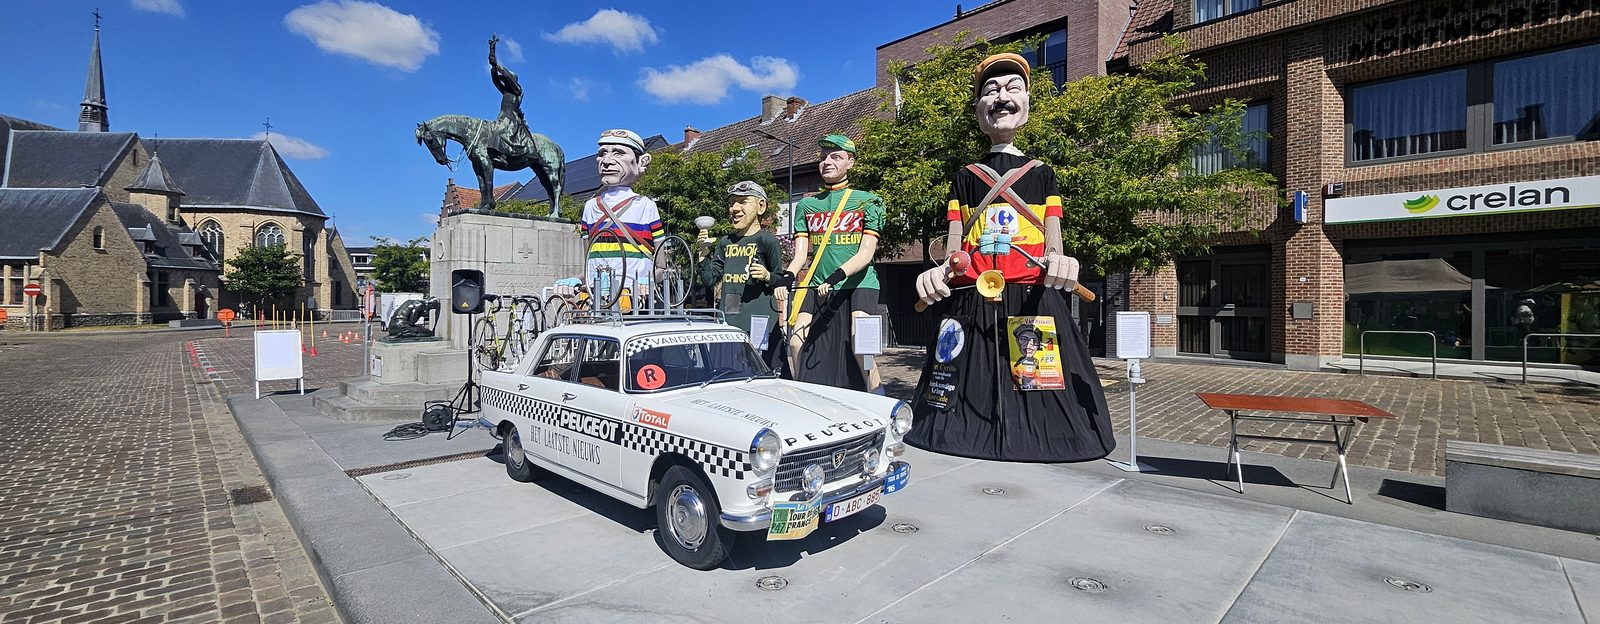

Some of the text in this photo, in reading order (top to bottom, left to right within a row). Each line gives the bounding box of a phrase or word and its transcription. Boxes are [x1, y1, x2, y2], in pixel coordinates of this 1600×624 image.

[1446, 186, 1570, 211] crelan
[652, 333, 741, 345] VANDECASTEELE
[644, 368, 657, 382] R
[560, 409, 619, 442] PEUGEOT
[640, 411, 668, 427] TOTAL
[783, 418, 884, 447] PEUGEOT
[530, 424, 601, 465] HET LAATSTE NIEUWS
[887, 484, 896, 493] 16
[788, 508, 807, 522] TOUR
[770, 521, 786, 534] 247
